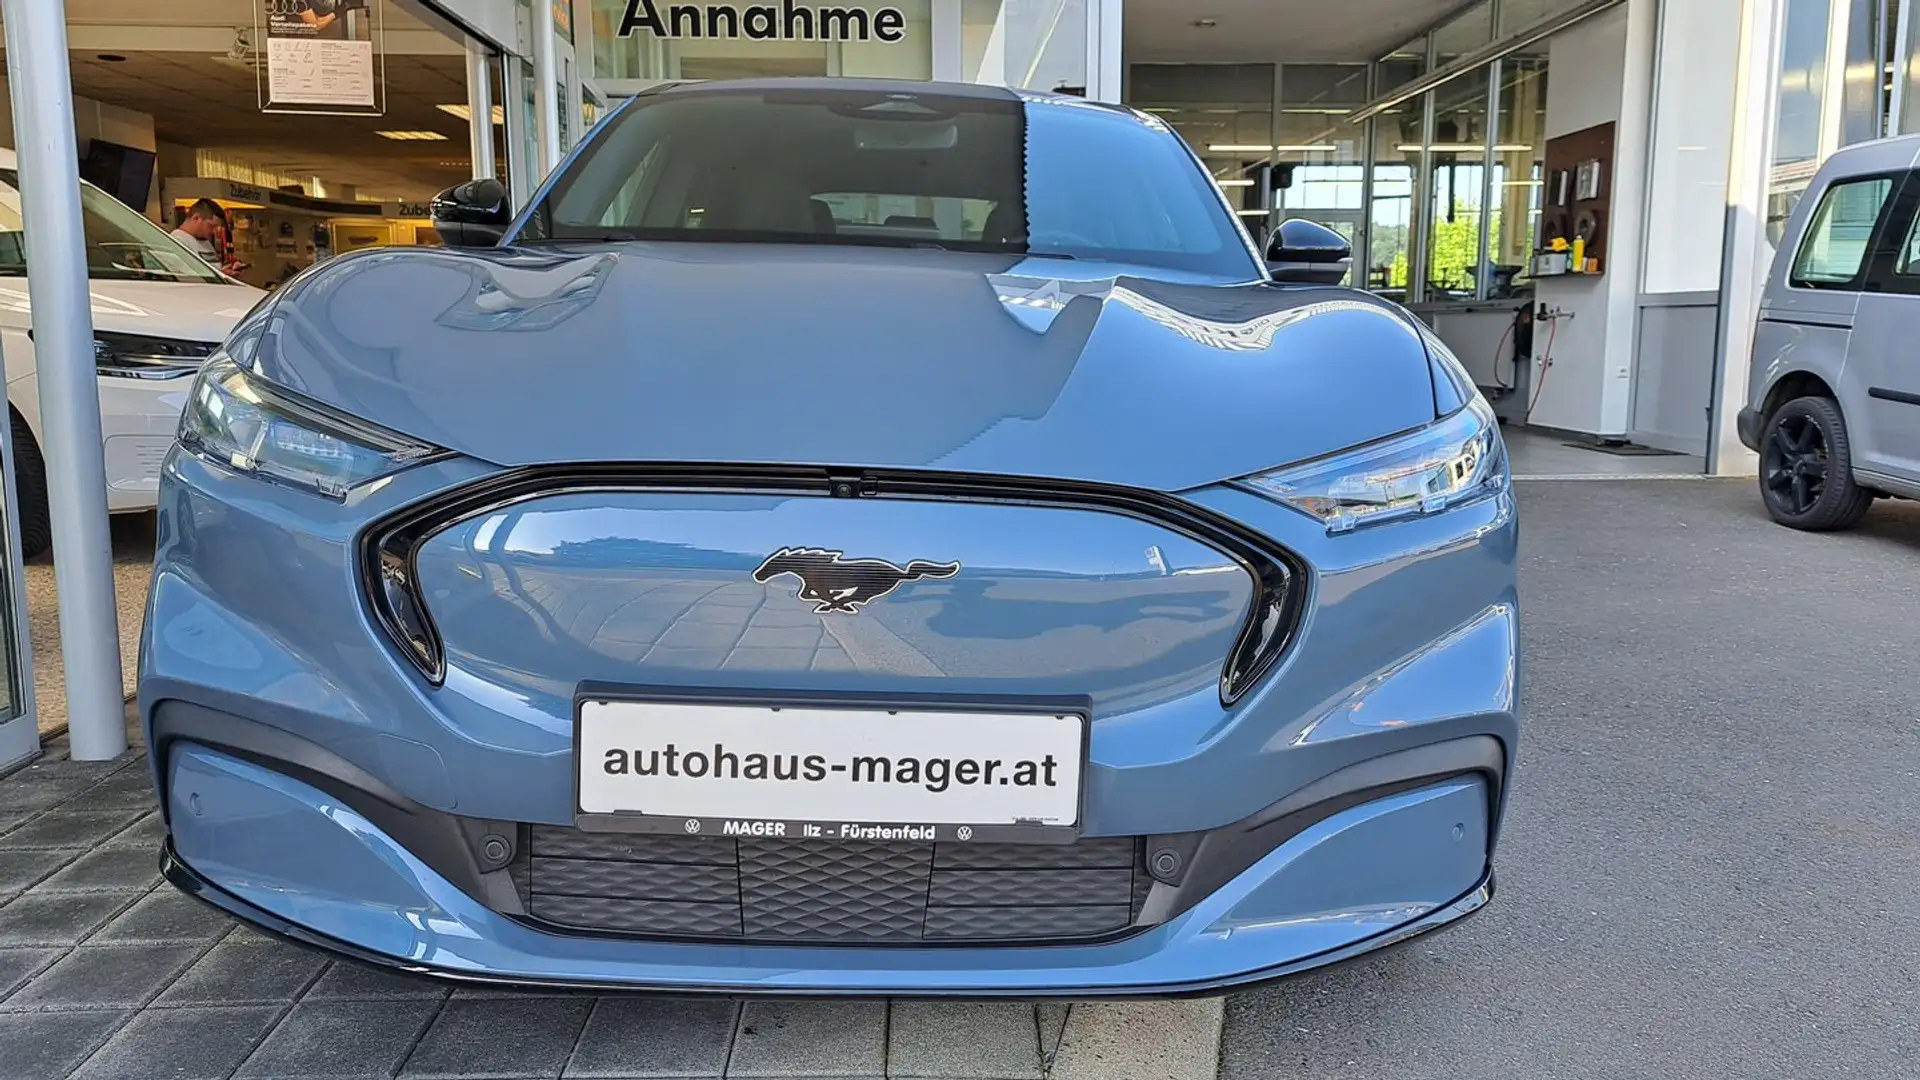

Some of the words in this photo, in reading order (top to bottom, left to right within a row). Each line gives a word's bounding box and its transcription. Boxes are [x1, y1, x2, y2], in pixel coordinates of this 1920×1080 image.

[616, 0, 906, 42] Annahme
[399, 203, 432, 216] Zube
[603, 743, 1058, 793] autohaus-mager.at
[723, 820, 786, 836] MAGER
[841, 824, 936, 840] Fürstenfeld
